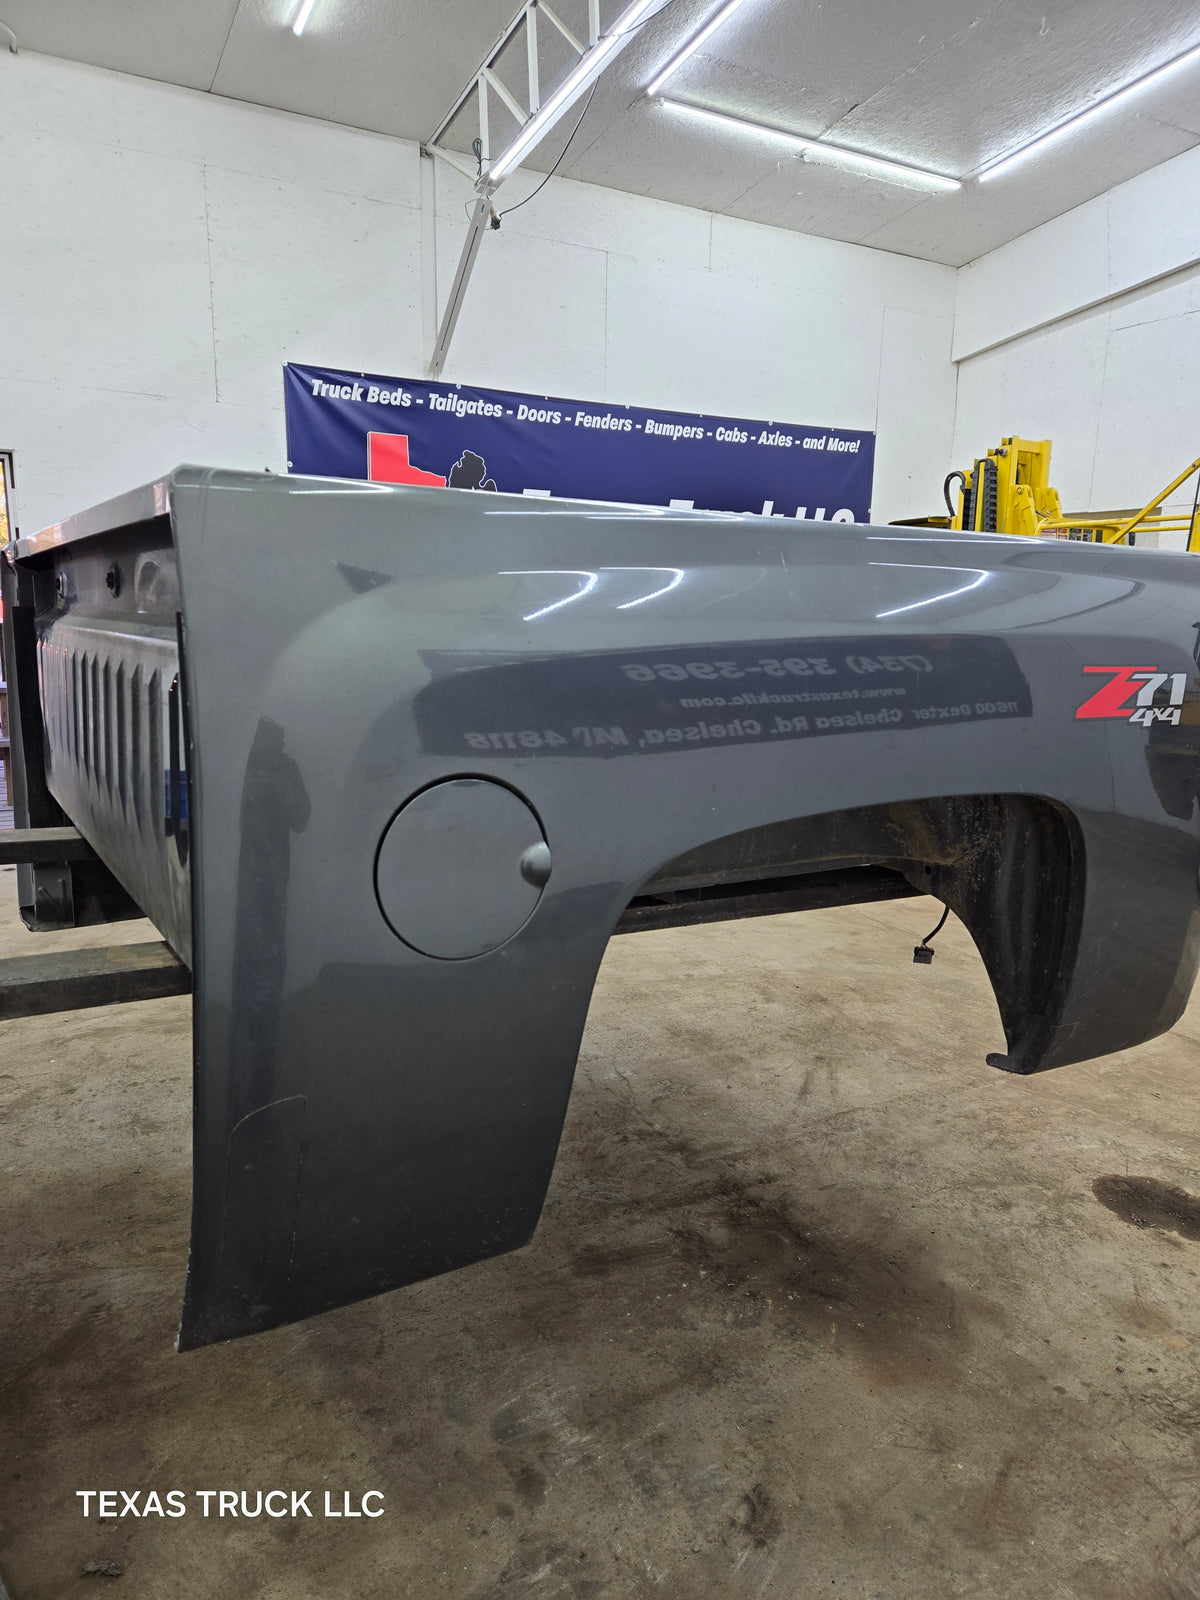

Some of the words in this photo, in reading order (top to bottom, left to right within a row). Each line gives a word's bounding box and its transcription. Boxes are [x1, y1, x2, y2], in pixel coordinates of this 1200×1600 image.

[311, 378, 364, 402] Truck
[366, 386, 412, 407] Beds
[429, 393, 502, 418] Tailgates
[517, 404, 561, 425] Doors
[574, 411, 633, 431] Fenders
[645, 418, 704, 441] Bumpers
[715, 426, 748, 443] Cabs
[758, 430, 793, 447] Axles
[802, 436, 825, 451] and
[826, 437, 861, 454] More!
[1075, 665, 1188, 719] Z71
